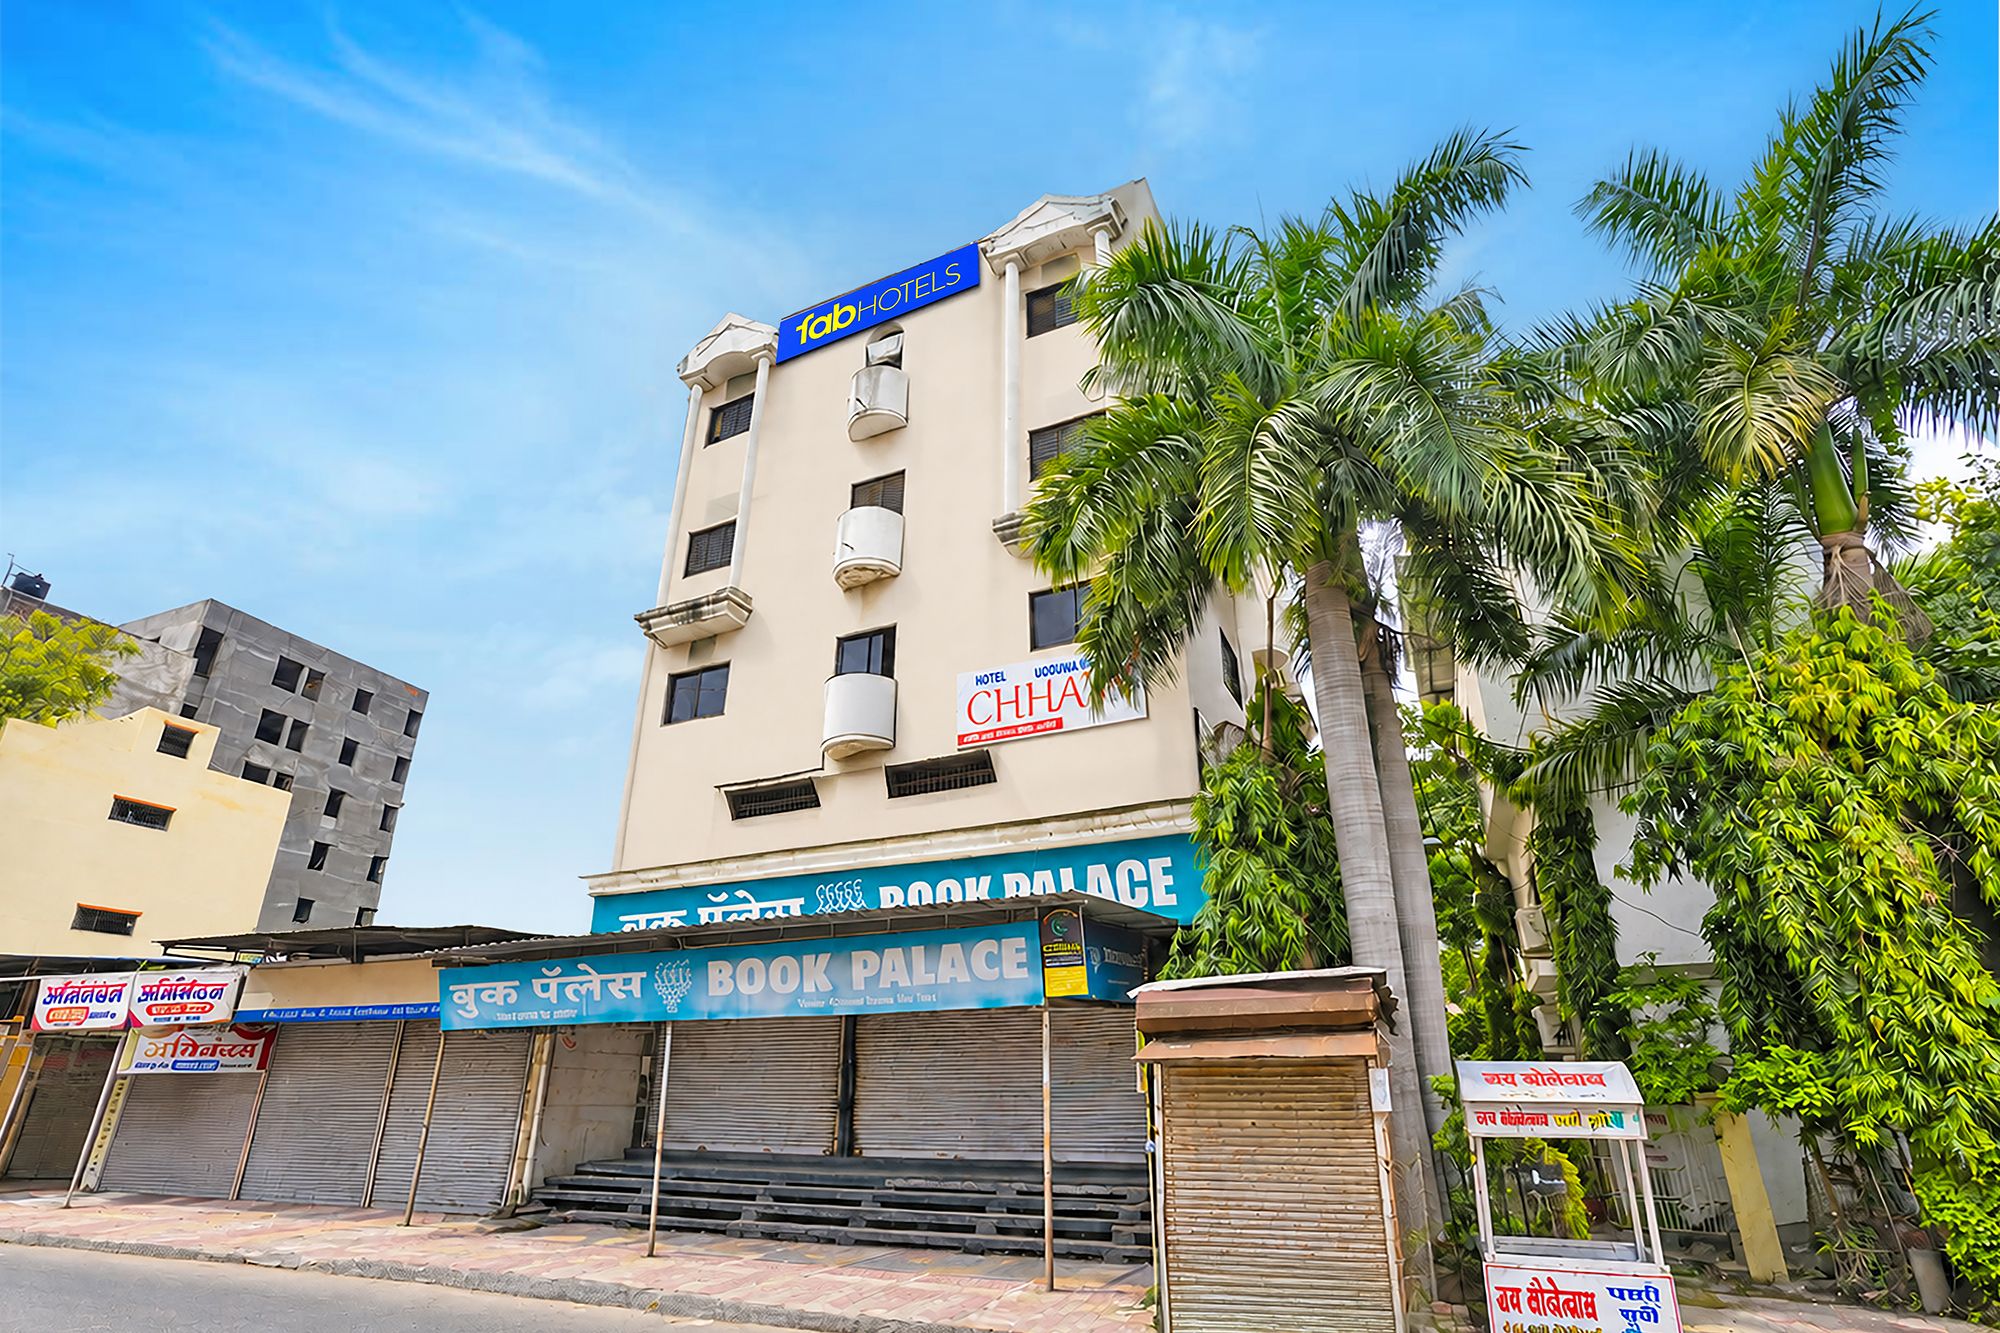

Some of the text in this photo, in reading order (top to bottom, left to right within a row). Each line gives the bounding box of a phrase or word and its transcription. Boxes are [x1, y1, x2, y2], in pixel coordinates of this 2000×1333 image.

[975, 671, 1007, 687] HOTEL
[1002, 856, 1178, 908] PALACE
[449, 963, 647, 1018] बुक पॅलेस
[707, 952, 834, 998] BOOK
[851, 937, 1030, 991] PALACE
